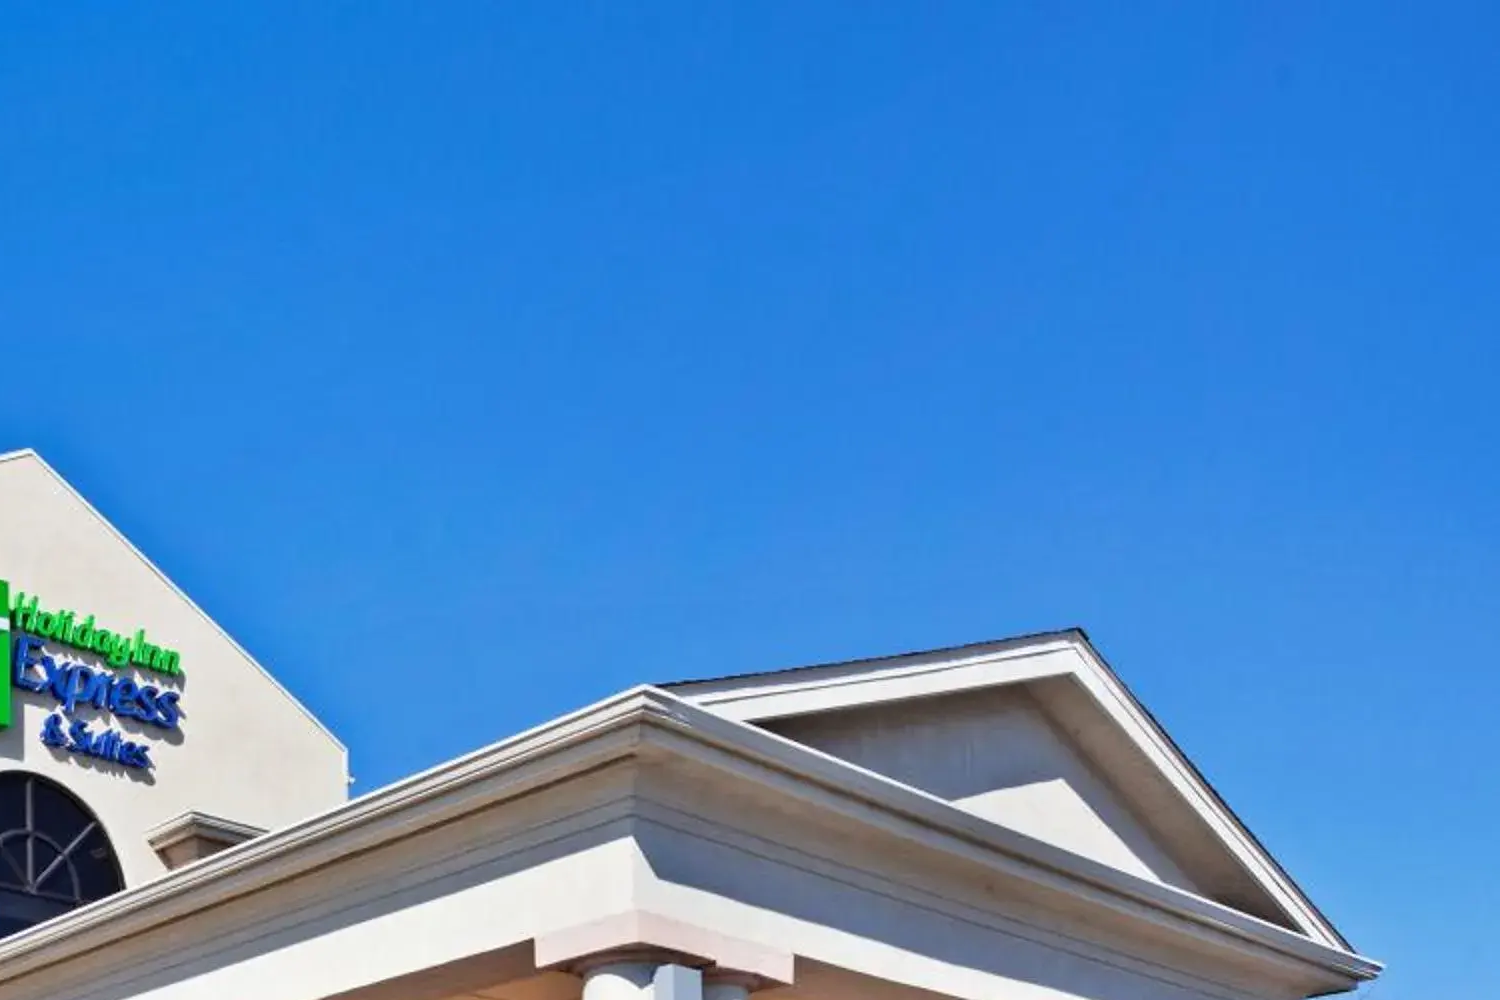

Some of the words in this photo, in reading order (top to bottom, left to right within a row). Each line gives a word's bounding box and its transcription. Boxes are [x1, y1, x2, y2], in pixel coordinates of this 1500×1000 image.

[13, 591, 131, 668] Holiday
[131, 628, 181, 675] Inn
[13, 632, 181, 729] Express
[40, 713, 69, 747] &
[68, 719, 150, 769] Suites
